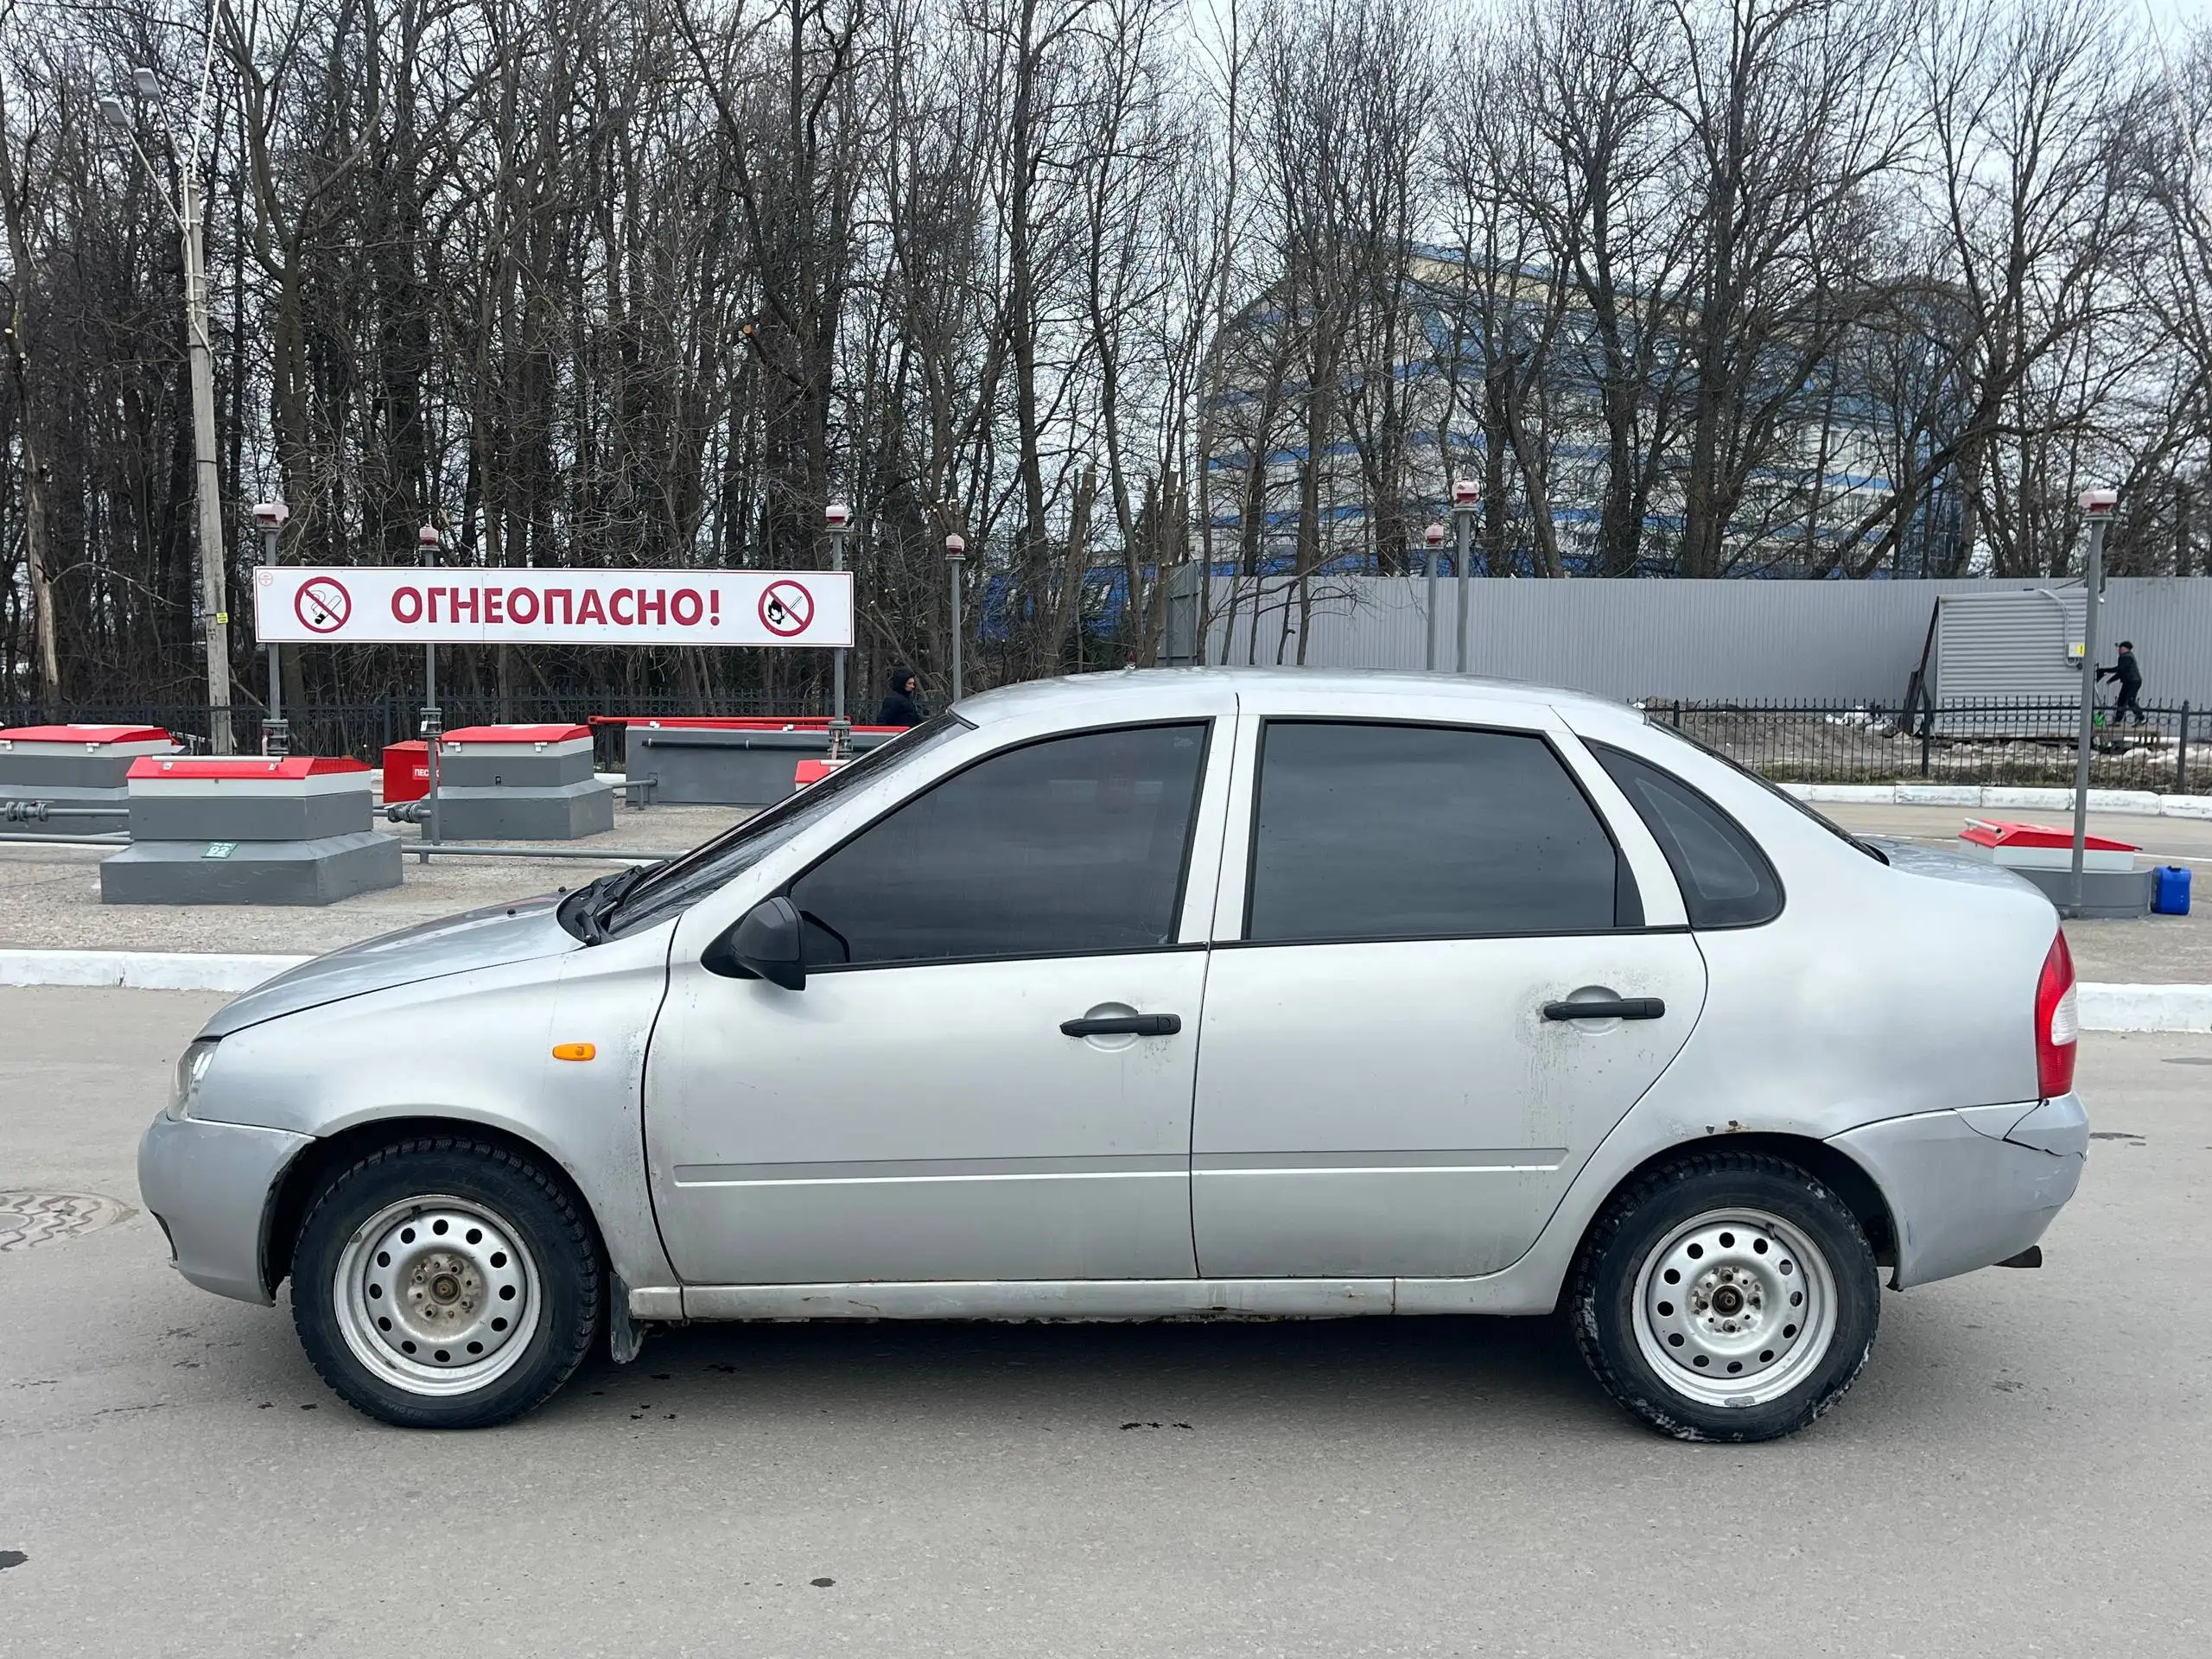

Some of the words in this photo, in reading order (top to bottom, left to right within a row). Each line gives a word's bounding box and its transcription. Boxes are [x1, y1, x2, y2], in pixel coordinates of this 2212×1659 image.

[391, 586, 720, 626] ОГНЕОПАСНО!
[414, 768, 440, 778] ПЕСК
[208, 846, 230, 855] 92
